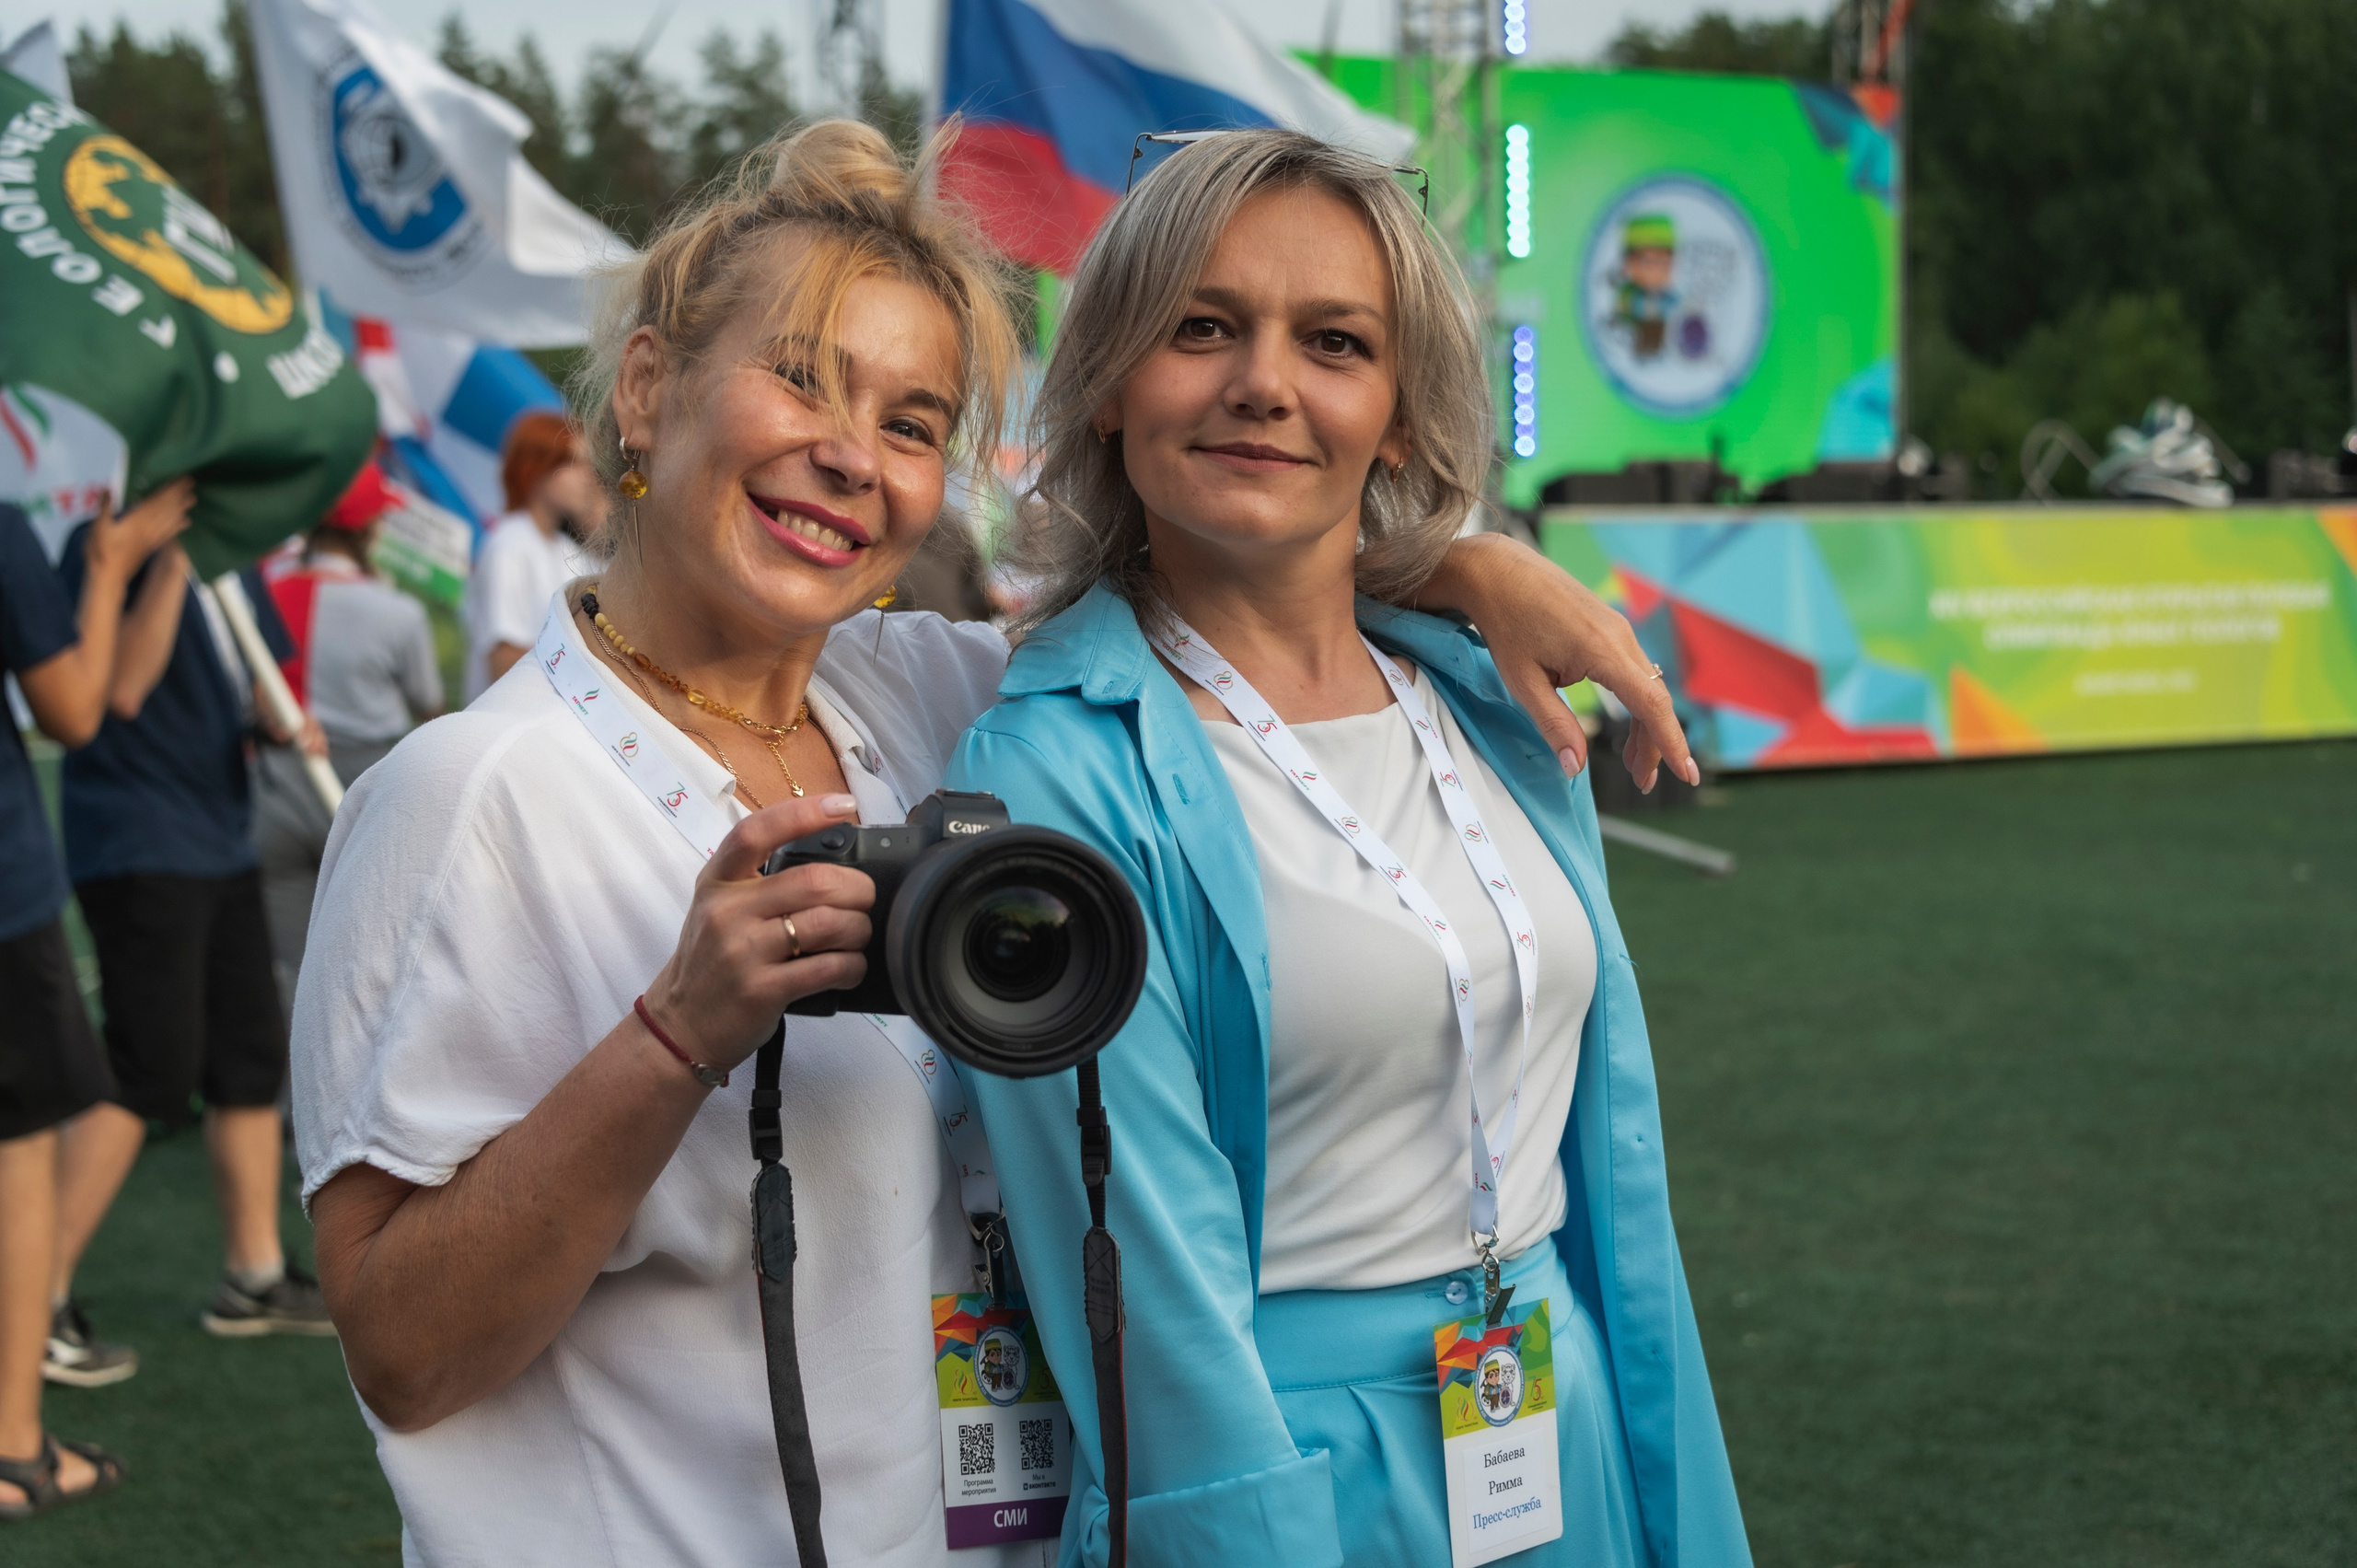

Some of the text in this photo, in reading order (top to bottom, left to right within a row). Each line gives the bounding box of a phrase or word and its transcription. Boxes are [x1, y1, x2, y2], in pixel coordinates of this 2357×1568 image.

[573, 695, 588, 715] TATNEFT
[1257, 714, 1278, 733] 75
[667, 782, 688, 807] 75
[1483, 1447, 1526, 1469] Бабаева
[962, 1488, 996, 1496] мероприятия
[964, 1479, 993, 1487] Программа
[1488, 1476, 1523, 1495] Римма
[993, 1508, 1028, 1527] СМИ
[1473, 1496, 1542, 1529] Пресс-служба
